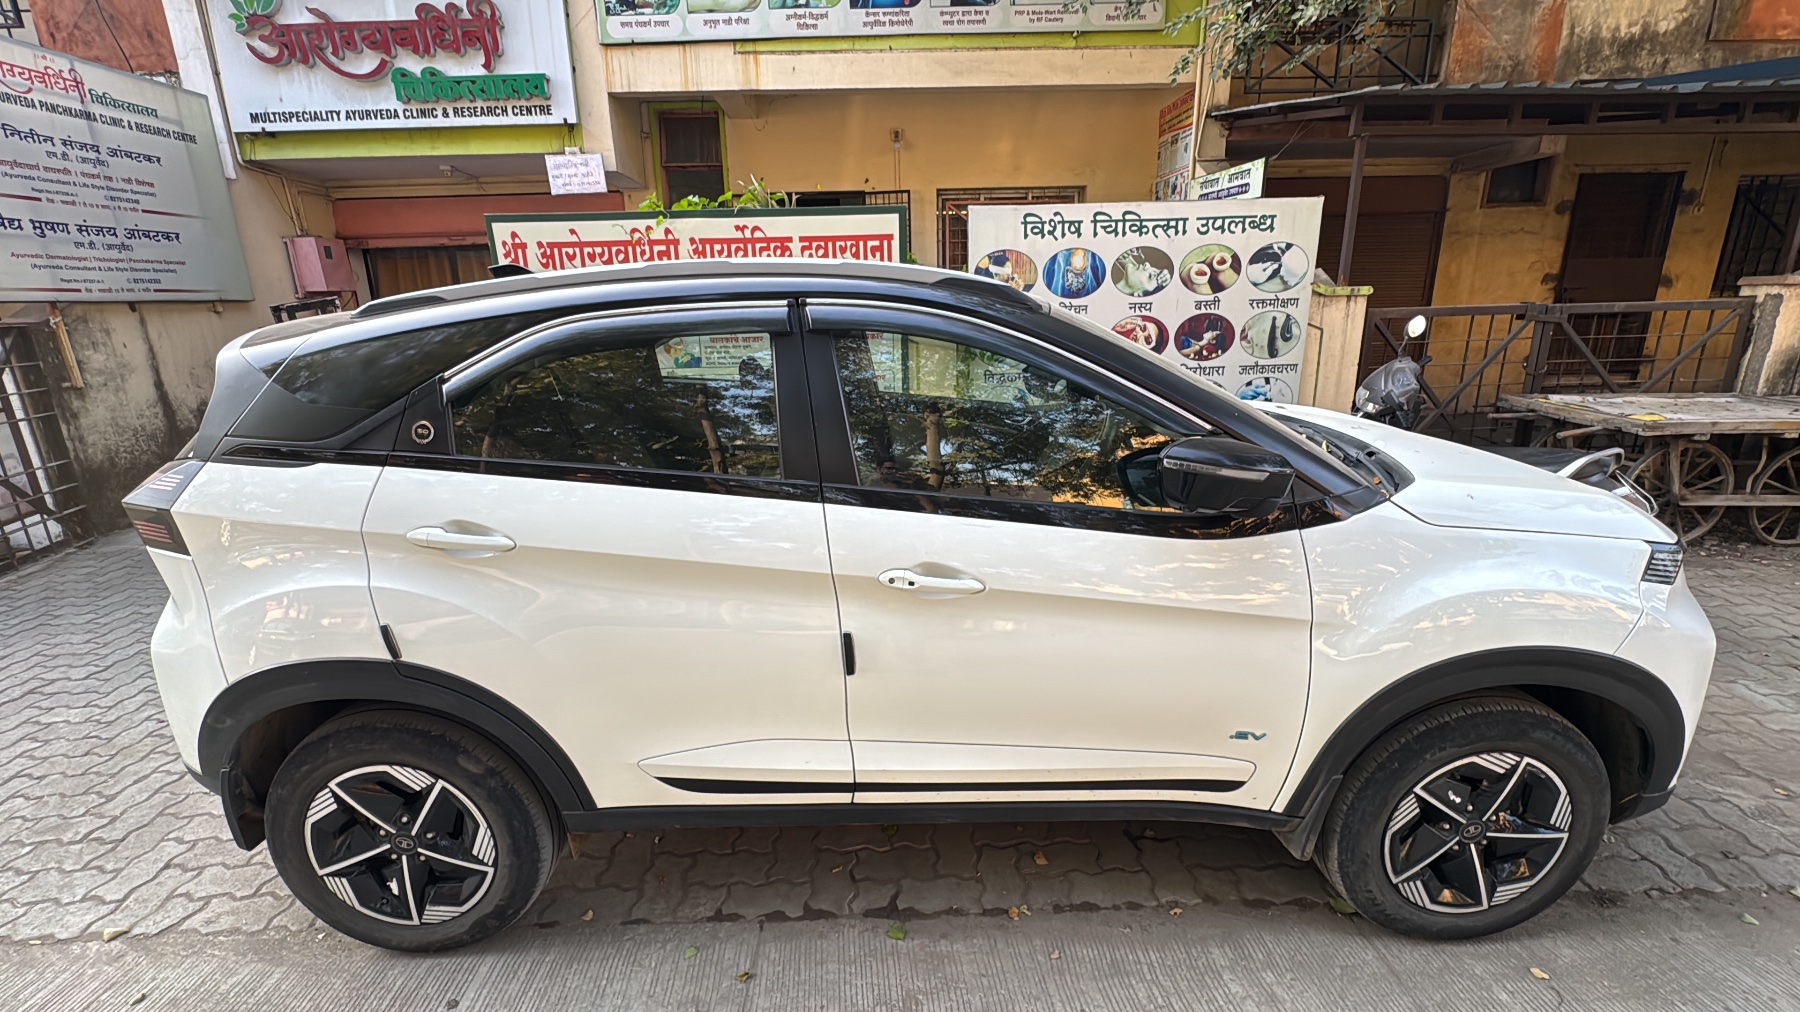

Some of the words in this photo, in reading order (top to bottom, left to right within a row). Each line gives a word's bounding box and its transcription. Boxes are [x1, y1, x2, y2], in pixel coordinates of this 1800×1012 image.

[391, 66, 551, 103] चिकित्सालय
[0, 90, 38, 111] URVEDA
[38, 99, 99, 123] PANCHKARMA
[99, 113, 126, 130] CLINIC
[126, 119, 134, 131] &
[134, 121, 172, 139] RESEARCH
[172, 129, 198, 145] CENTRE
[88, 88, 159, 119] चिकित्सालय
[249, 109, 342, 125] MULTISPECIALITY
[344, 108, 401, 122] AYURVEDA
[402, 107, 439, 121] CLINIC
[441, 107, 450, 119] &
[453, 106, 509, 119] RESEARCH
[511, 104, 553, 118] CENTRE
[1, 123, 56, 147] नितीन
[59, 135, 102, 156] संजय
[29, 218, 71, 239] भुषण
[74, 218, 118, 239] संजय
[1021, 211, 1083, 241] विशेष
[1091, 210, 1188, 239] चिकित्सा
[1196, 213, 1278, 237] उपलब्ध
[502, 231, 529, 268] श्री
[1128, 302, 1153, 314] नस्य
[1194, 296, 1221, 311] बस्ती
[1248, 294, 1300, 310] रक्तमोक्षण
